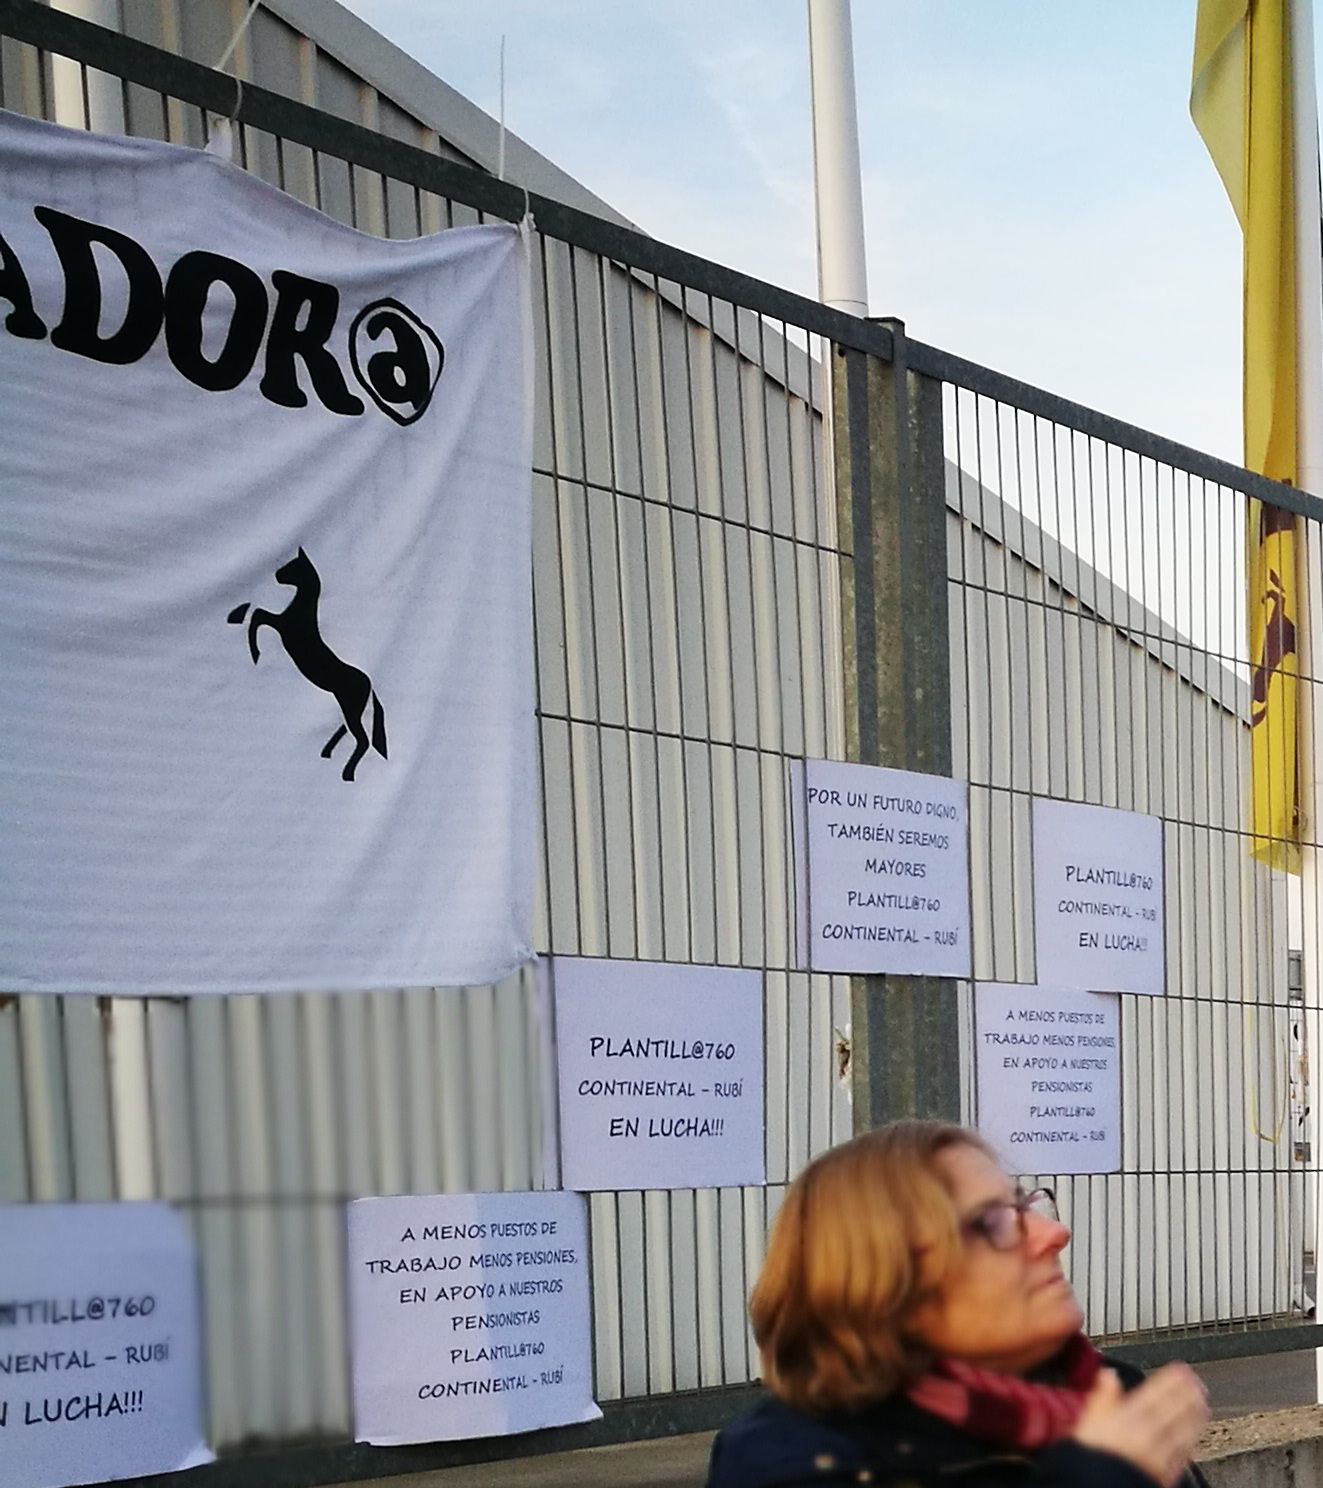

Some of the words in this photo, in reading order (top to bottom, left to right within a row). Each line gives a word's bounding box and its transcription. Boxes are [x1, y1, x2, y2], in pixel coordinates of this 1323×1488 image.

[808, 788, 841, 806] POR
[848, 792, 867, 807] UN
[873, 795, 922, 815] FUTURO
[828, 824, 893, 843] TAMBIÉN
[899, 830, 949, 849] SEREMOS
[865, 859, 926, 877] MAYORES
[1058, 900, 1132, 918] CONTINENTAL
[823, 924, 918, 943] CONTINENTAL
[1079, 932, 1098, 948] EN
[1006, 1010, 1014, 1020] A
[1018, 1011, 1055, 1022] MENOS
[1059, 1012, 1093, 1024] PUESTOS
[1095, 1014, 1104, 1024] DE
[590, 1037, 735, 1060] PLANTILL@760
[985, 1033, 1039, 1045] TRABAJO
[1043, 1034, 1074, 1046] MENOS
[1003, 1057, 1018, 1068] EN
[1023, 1058, 1057, 1069] APOYO
[1061, 1060, 1067, 1068] A
[1071, 1059, 1107, 1070] NUESTROS
[578, 1080, 695, 1097] CONTINENTAL
[714, 1079, 743, 1097] RUBÍ
[1032, 1081, 1092, 1092] PENSIONISTAS
[609, 1118, 639, 1137] EN
[649, 1118, 724, 1137] LUCHA!!!
[1010, 1131, 1079, 1142] CONTINENTAL
[401, 1227, 415, 1242] A
[423, 1224, 486, 1241] MENOS
[491, 1222, 537, 1238] PUESTOS
[541, 1222, 557, 1235] DE
[366, 1256, 461, 1274] TRABAJO
[470, 1253, 512, 1268] MENOS
[400, 1288, 426, 1303] EN
[435, 1283, 495, 1301] APOYO
[499, 1284, 507, 1297] A
[510, 1279, 562, 1296] NUESTROS
[452, 1310, 540, 1331] PENSIONISTAS
[418, 1375, 527, 1400] CONTINENTAL
[541, 1365, 564, 1386] RUBÍ
[25, 1390, 143, 1425] LUCHA!!!
